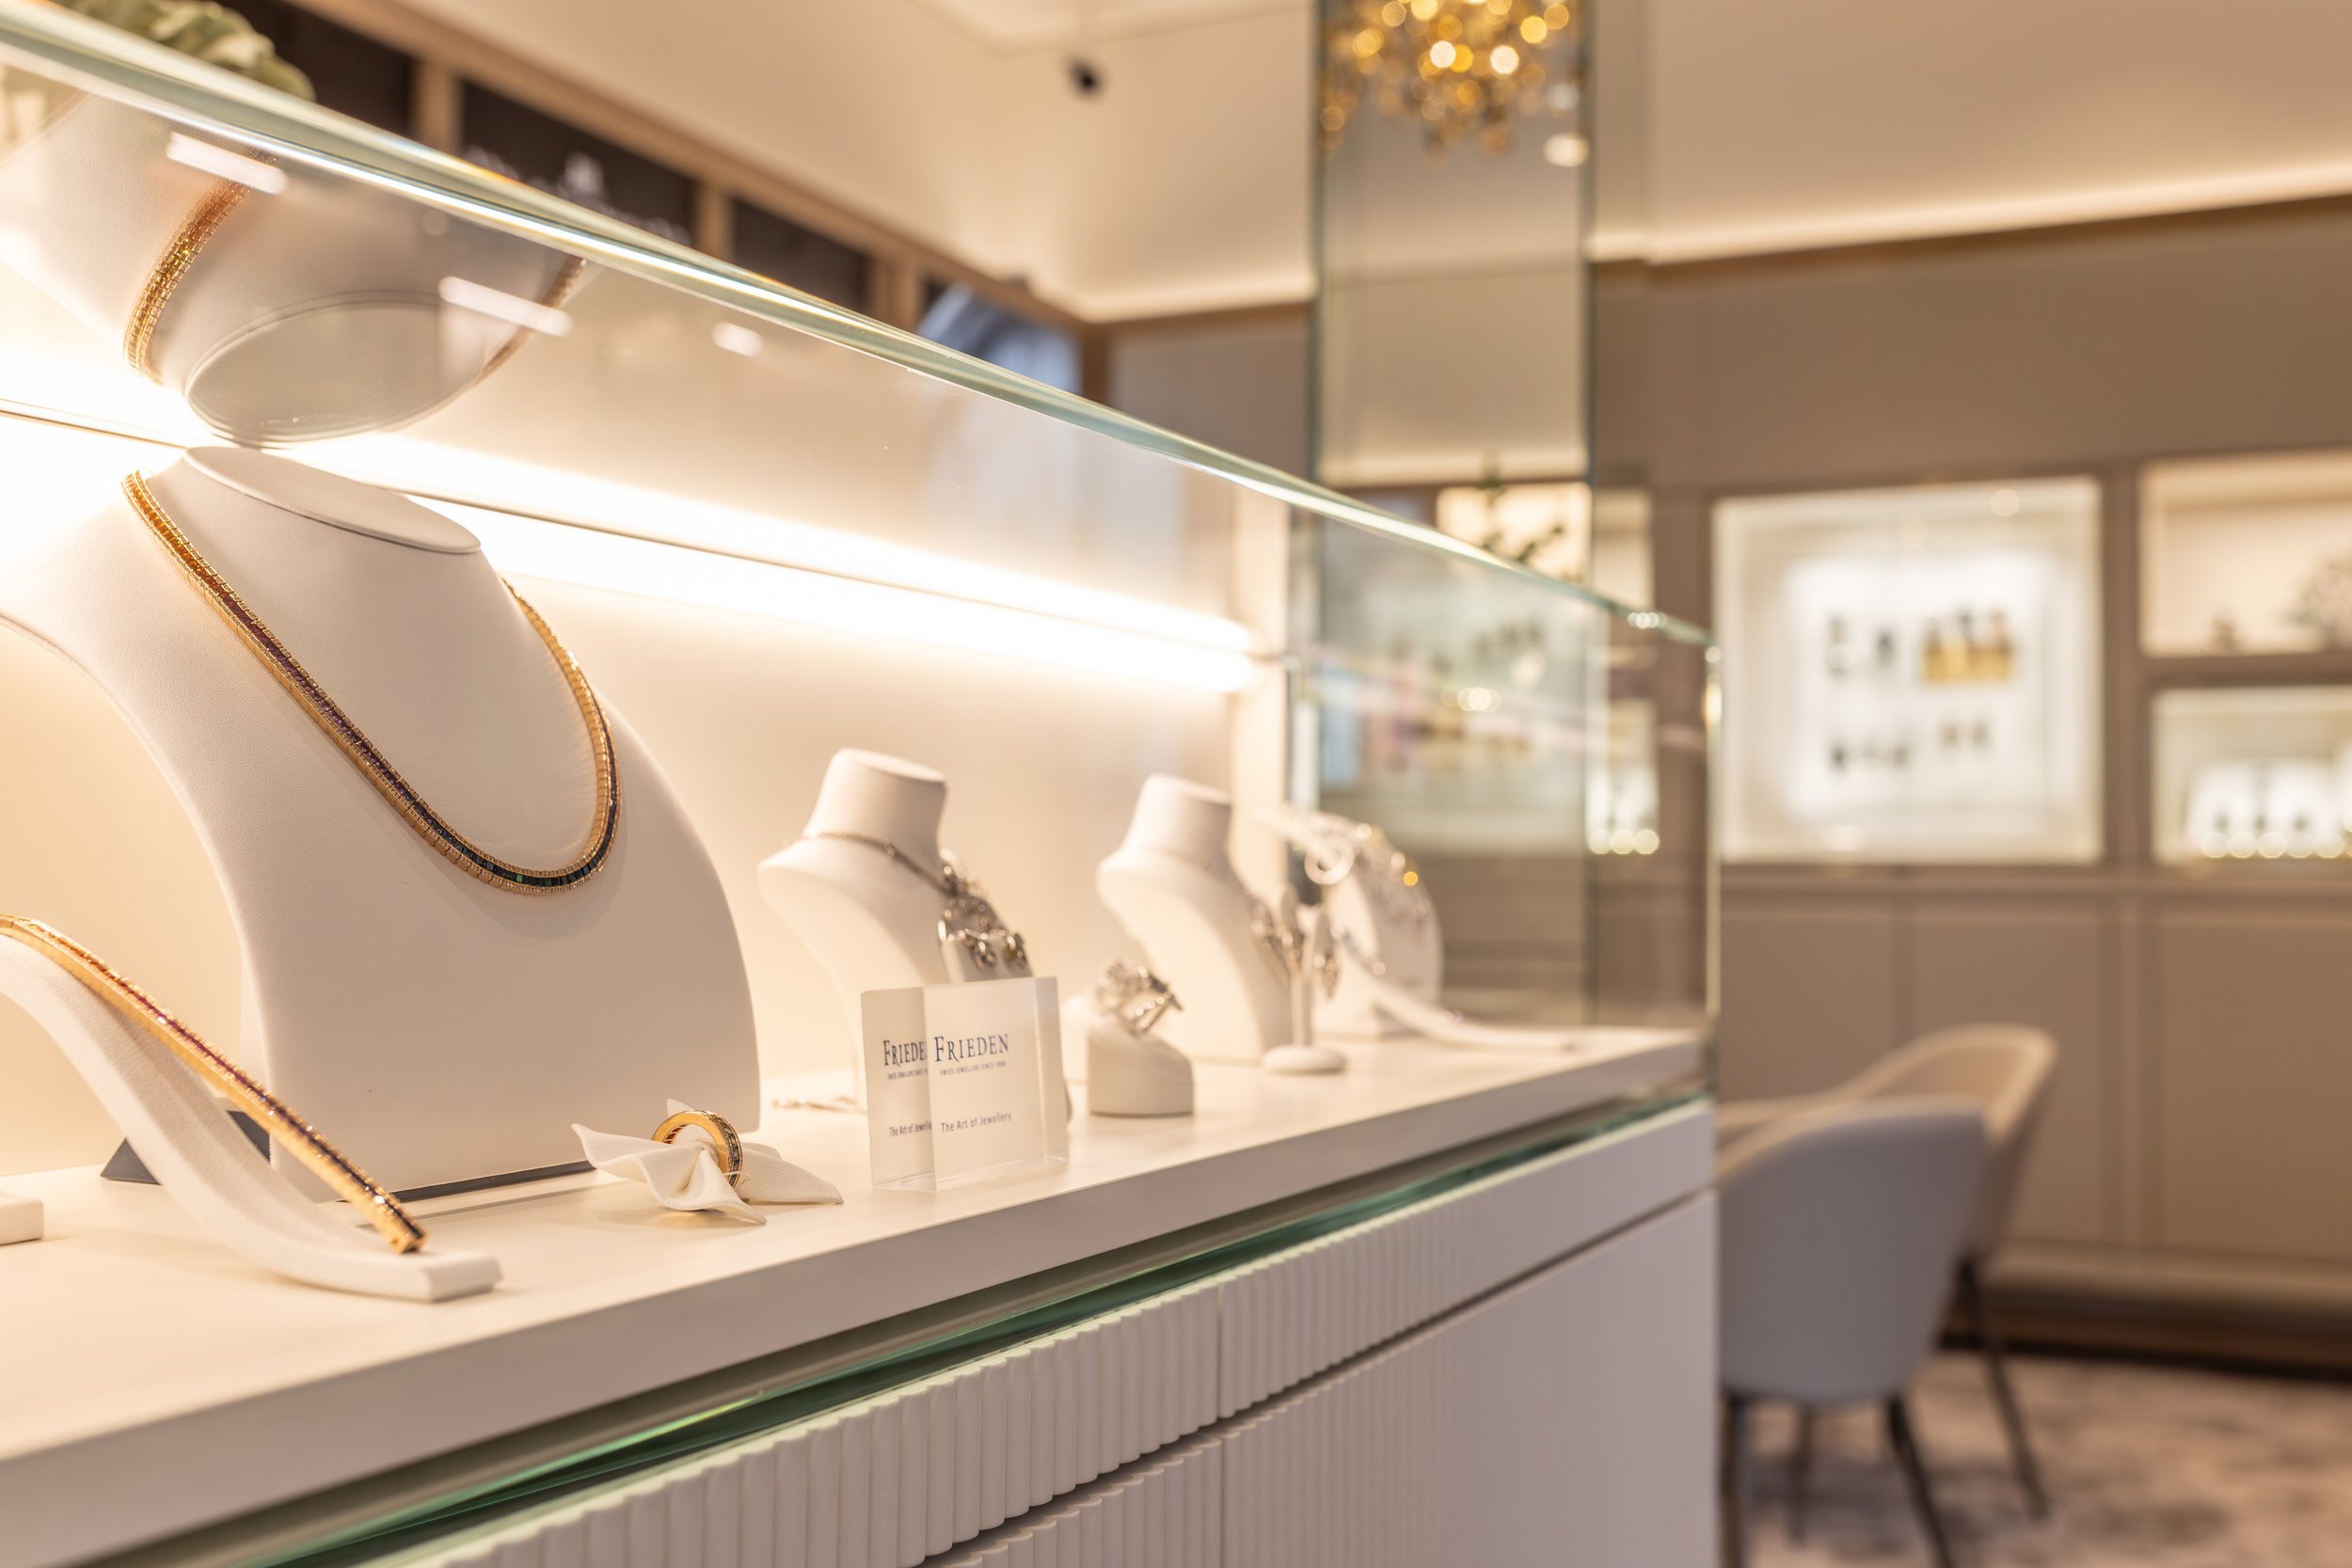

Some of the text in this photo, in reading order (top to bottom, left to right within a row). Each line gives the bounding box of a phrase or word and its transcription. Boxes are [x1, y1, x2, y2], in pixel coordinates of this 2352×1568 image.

[933, 1034, 1009, 1062] FRIEDEN
[941, 1112, 1012, 1132] The Art of Jewellery
